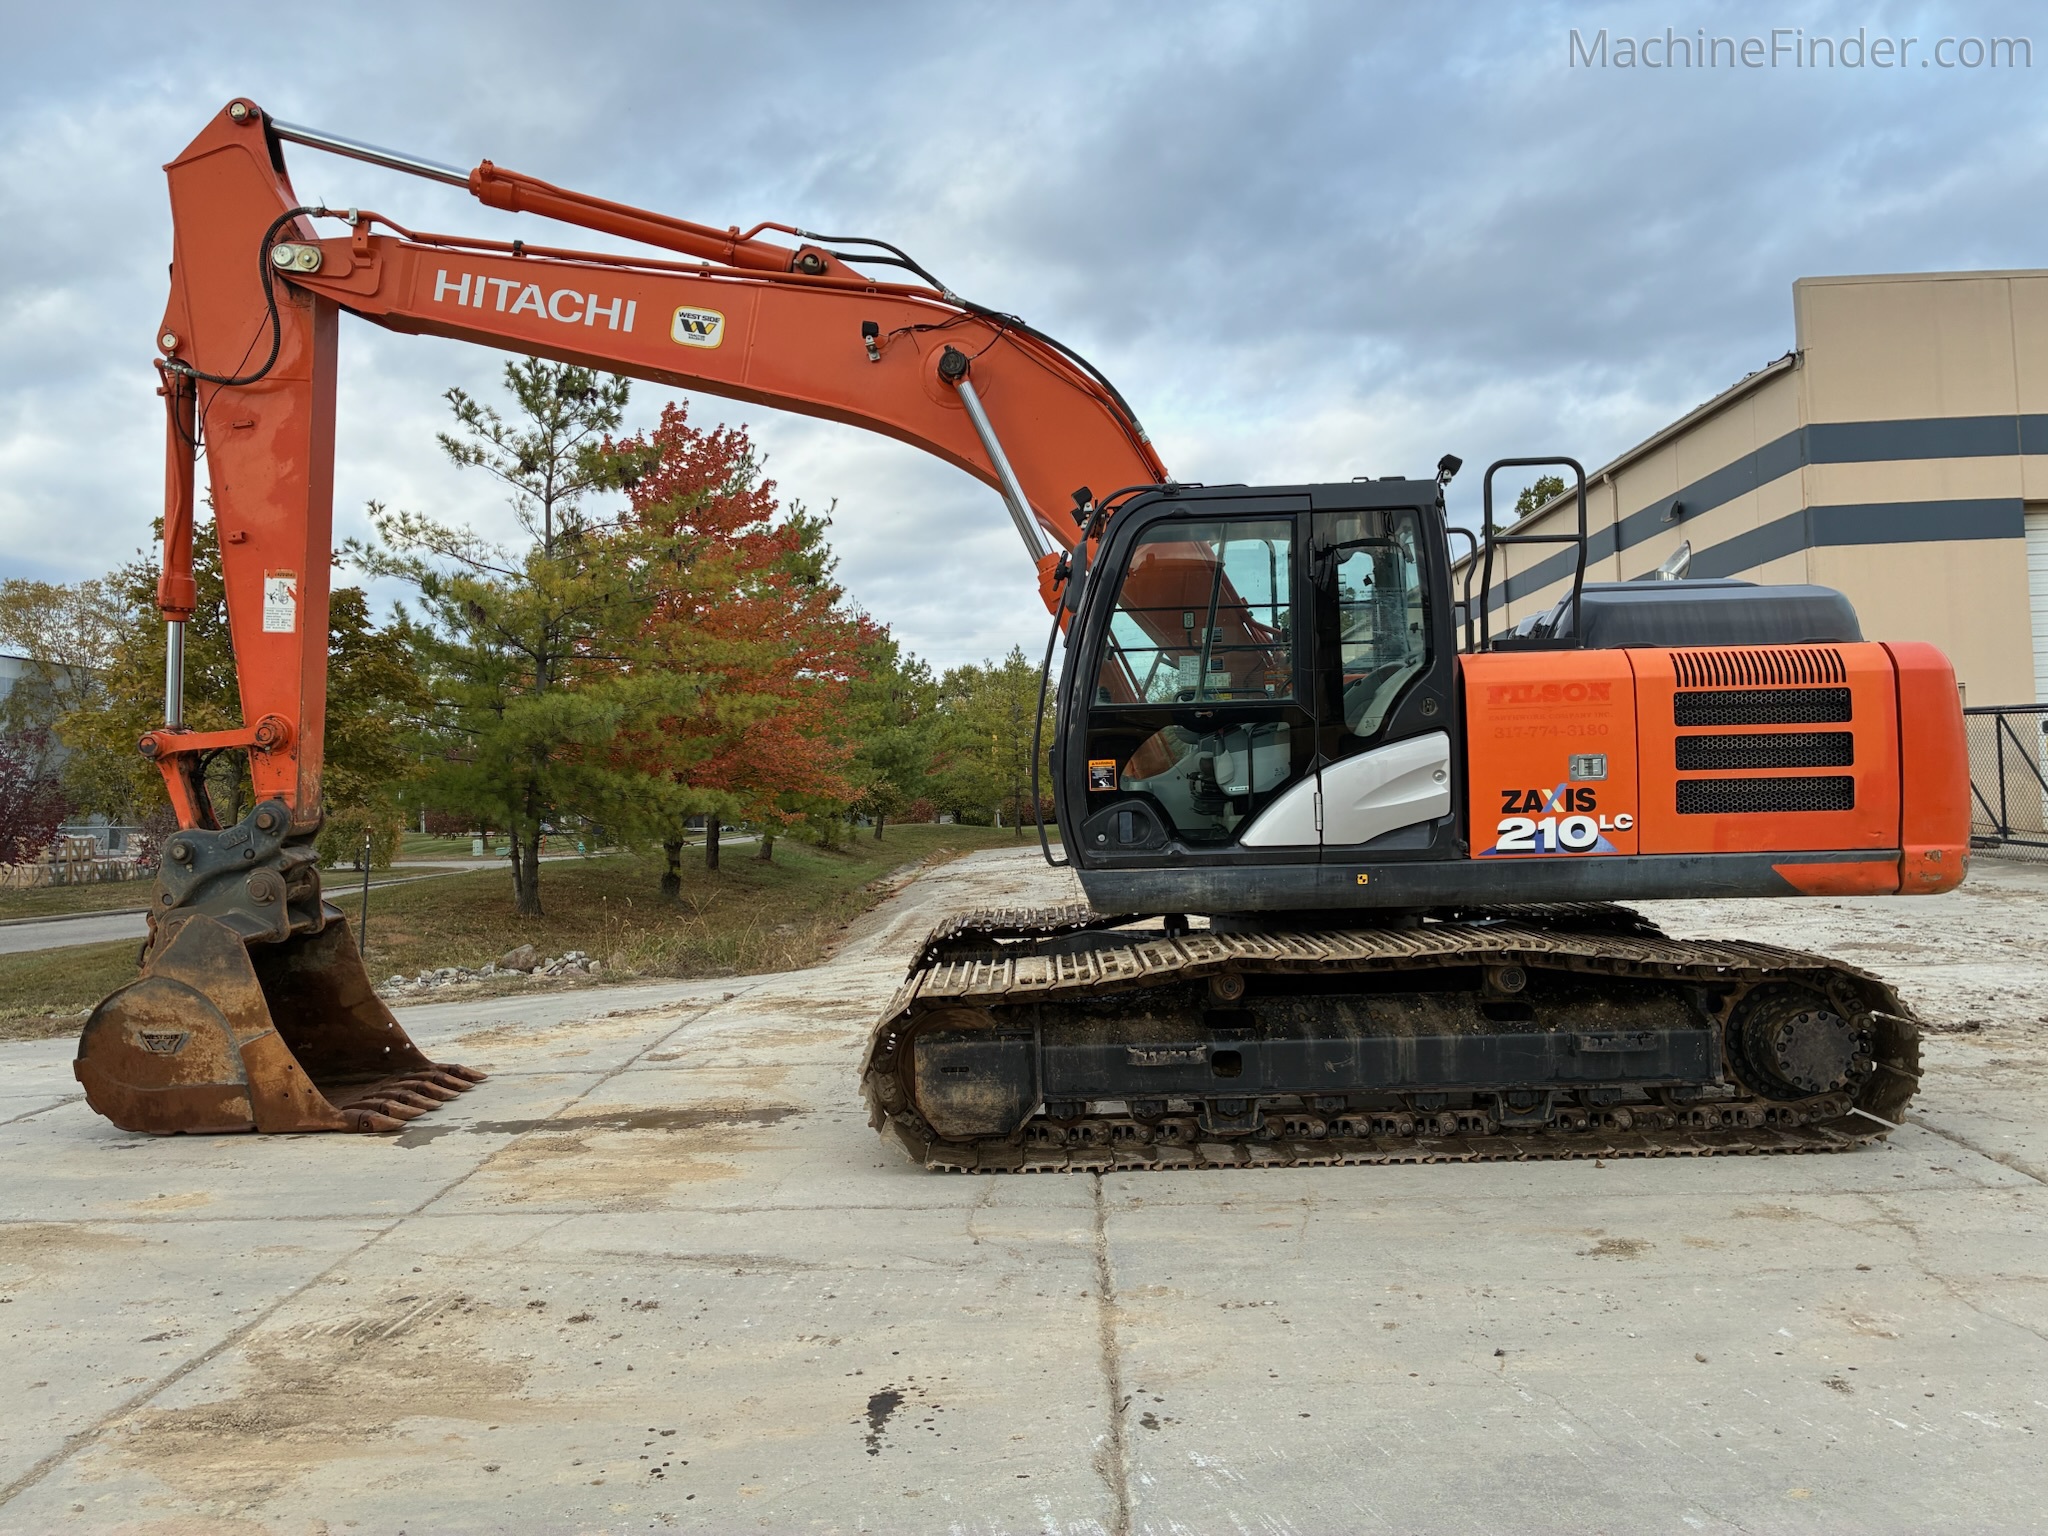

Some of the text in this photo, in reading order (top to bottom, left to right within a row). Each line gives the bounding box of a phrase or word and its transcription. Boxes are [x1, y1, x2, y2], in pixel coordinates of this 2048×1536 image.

[433, 269, 637, 332] HITACHI
[678, 311, 721, 323] WEST SIDE
[1487, 682, 1611, 705] FILSON
[1595, 711, 1613, 719] INC.
[1494, 724, 1609, 739] 317-774-3180
[1501, 783, 1597, 814] ZAXIS
